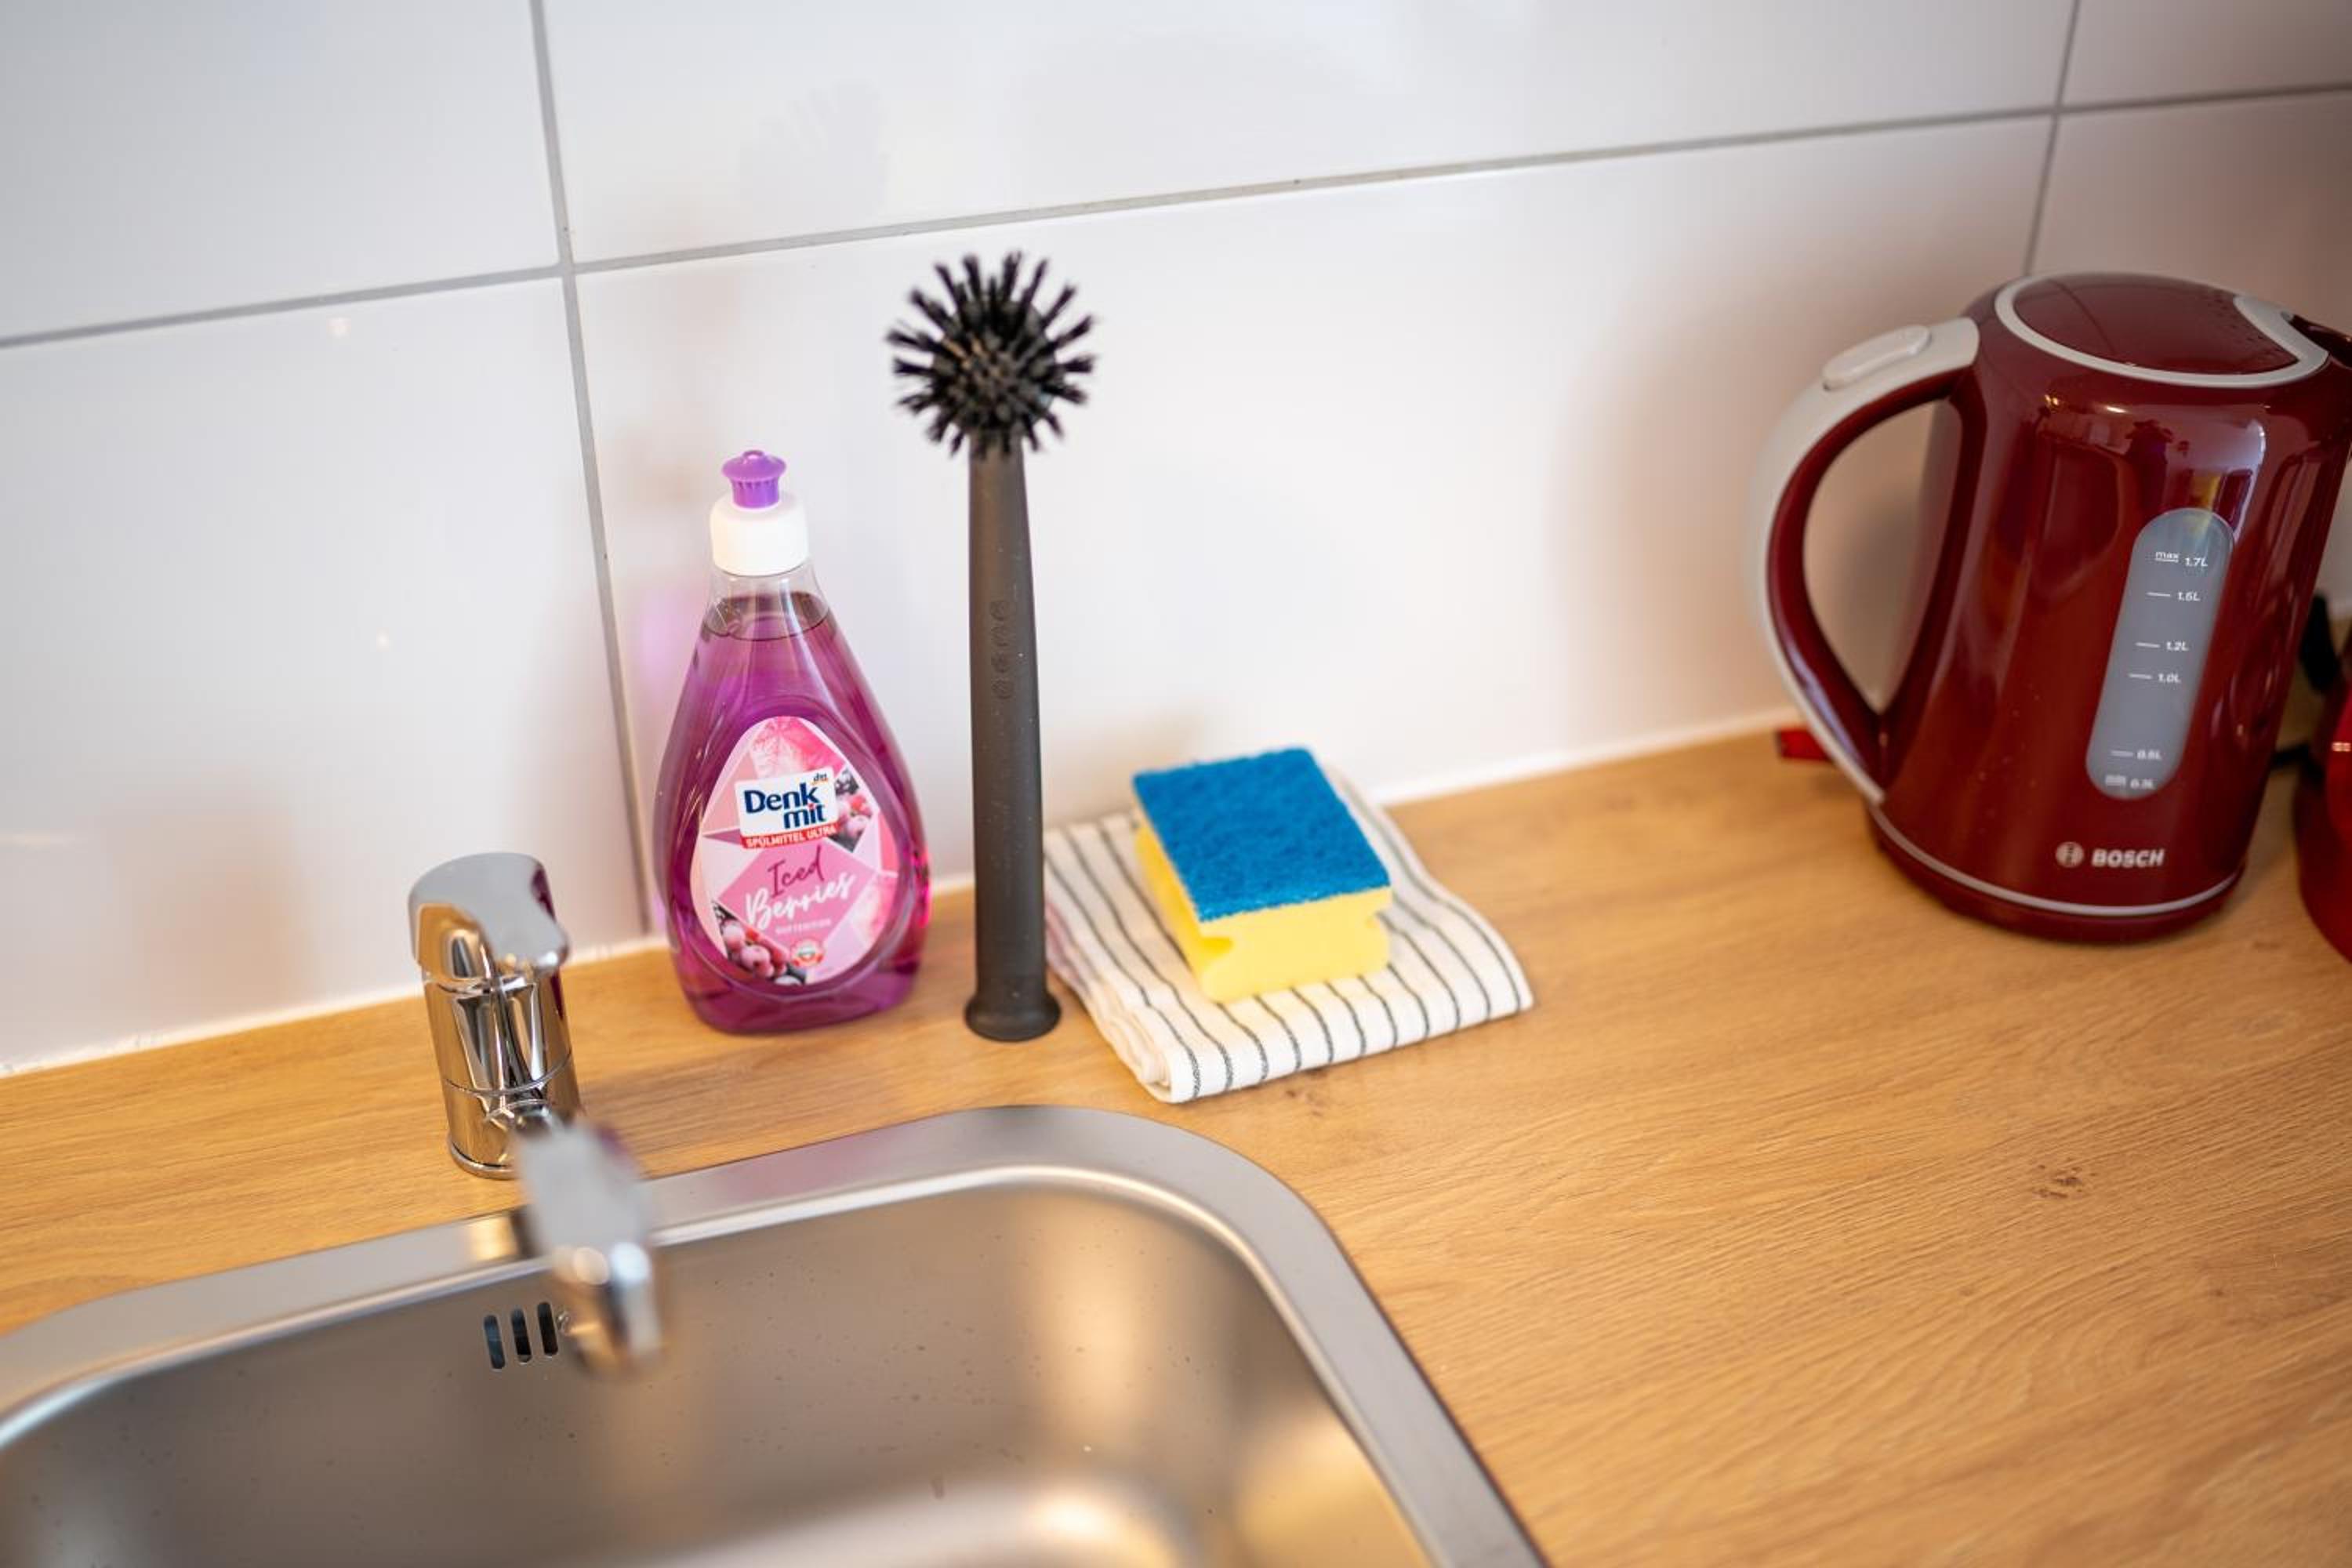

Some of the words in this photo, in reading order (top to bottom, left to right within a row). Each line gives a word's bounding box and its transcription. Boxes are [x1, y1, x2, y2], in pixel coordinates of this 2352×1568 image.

[2185, 557, 2208, 567] 1.7L
[744, 782, 821, 814] Denk
[784, 803, 826, 829] mit
[746, 831, 804, 848] SPÜLMITTEL
[807, 825, 837, 840] ULTRA
[2092, 848, 2165, 868] BOSCH
[768, 845, 825, 898] Iced
[746, 872, 856, 931] Berries
